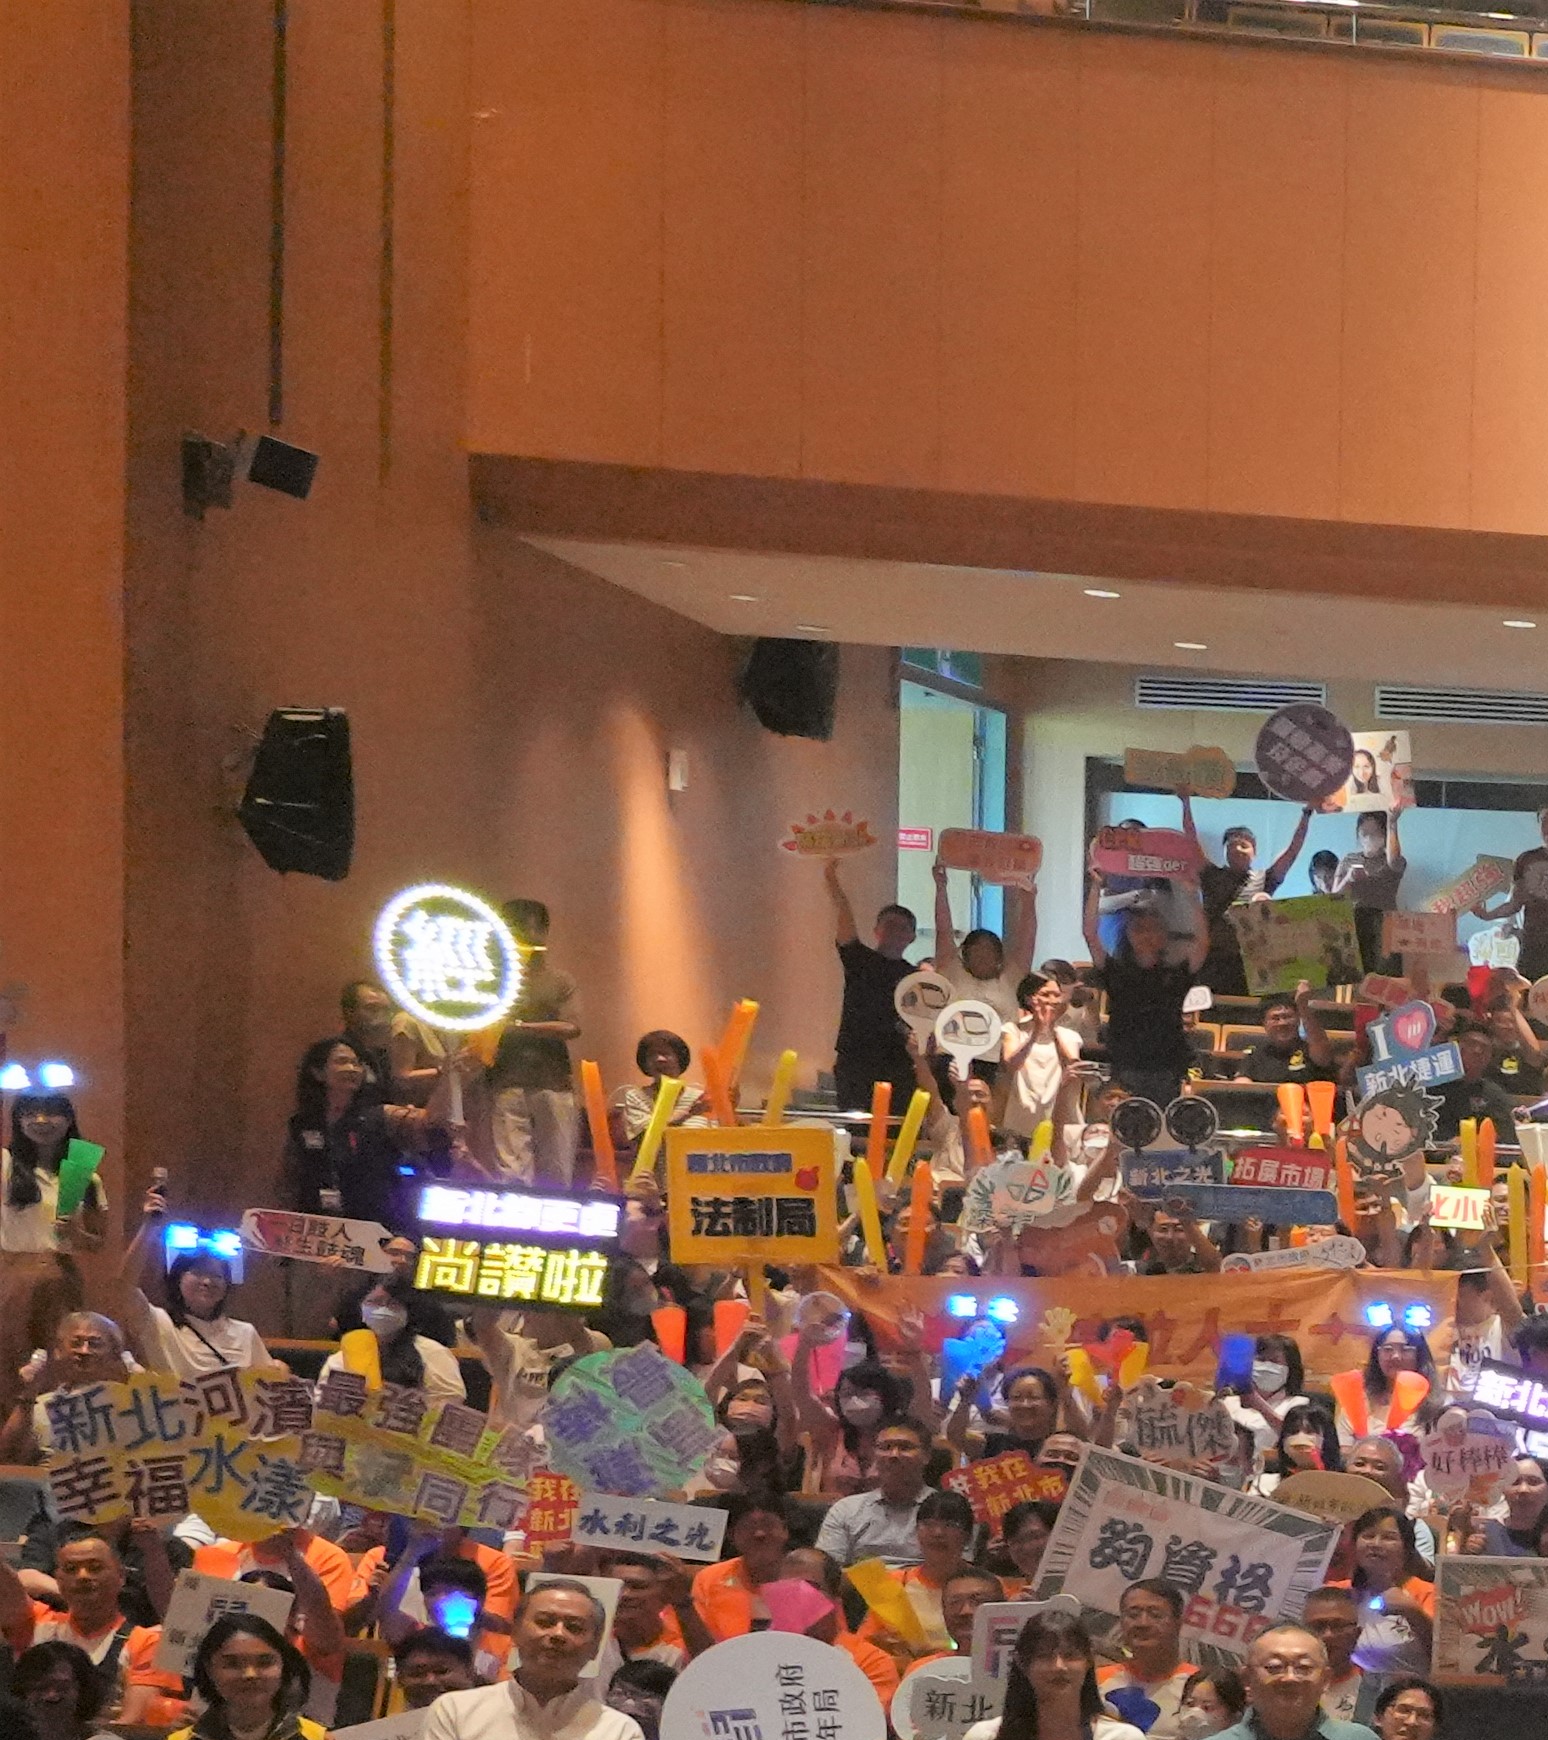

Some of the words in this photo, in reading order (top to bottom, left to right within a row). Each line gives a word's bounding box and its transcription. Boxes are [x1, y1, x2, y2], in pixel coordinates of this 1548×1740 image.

[1364, 1048, 1455, 1096] 新北捷運
[1234, 1157, 1325, 1191] 拓展市場
[690, 1196, 818, 1237] 法制局
[416, 1238, 606, 1305] 尚讚啦
[51, 1368, 315, 1455] 新北河濱
[49, 1436, 313, 1526] 幸福水漾
[925, 1689, 993, 1724] 新北
